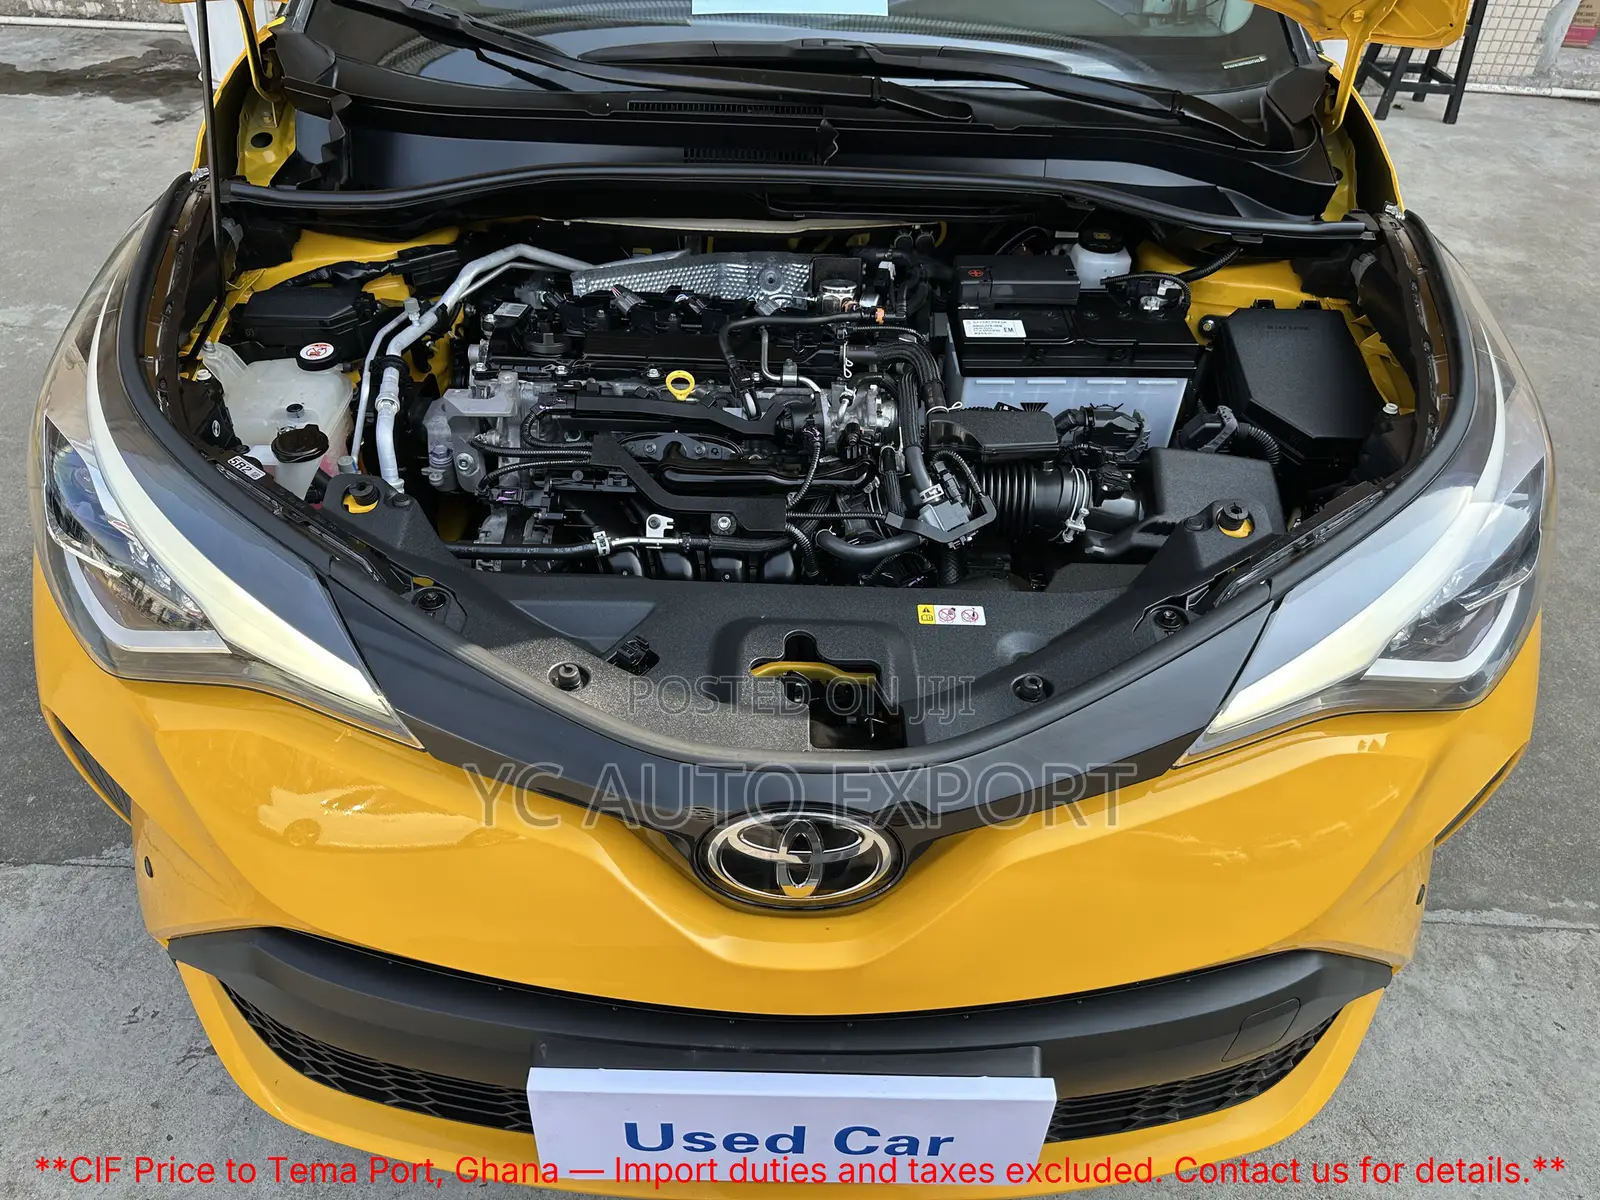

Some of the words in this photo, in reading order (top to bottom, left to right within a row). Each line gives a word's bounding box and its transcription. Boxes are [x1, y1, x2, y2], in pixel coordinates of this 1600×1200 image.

[229, 457, 252, 472] 5R2
[624, 1122, 806, 1153] Used
[834, 1126, 955, 1156] Car
